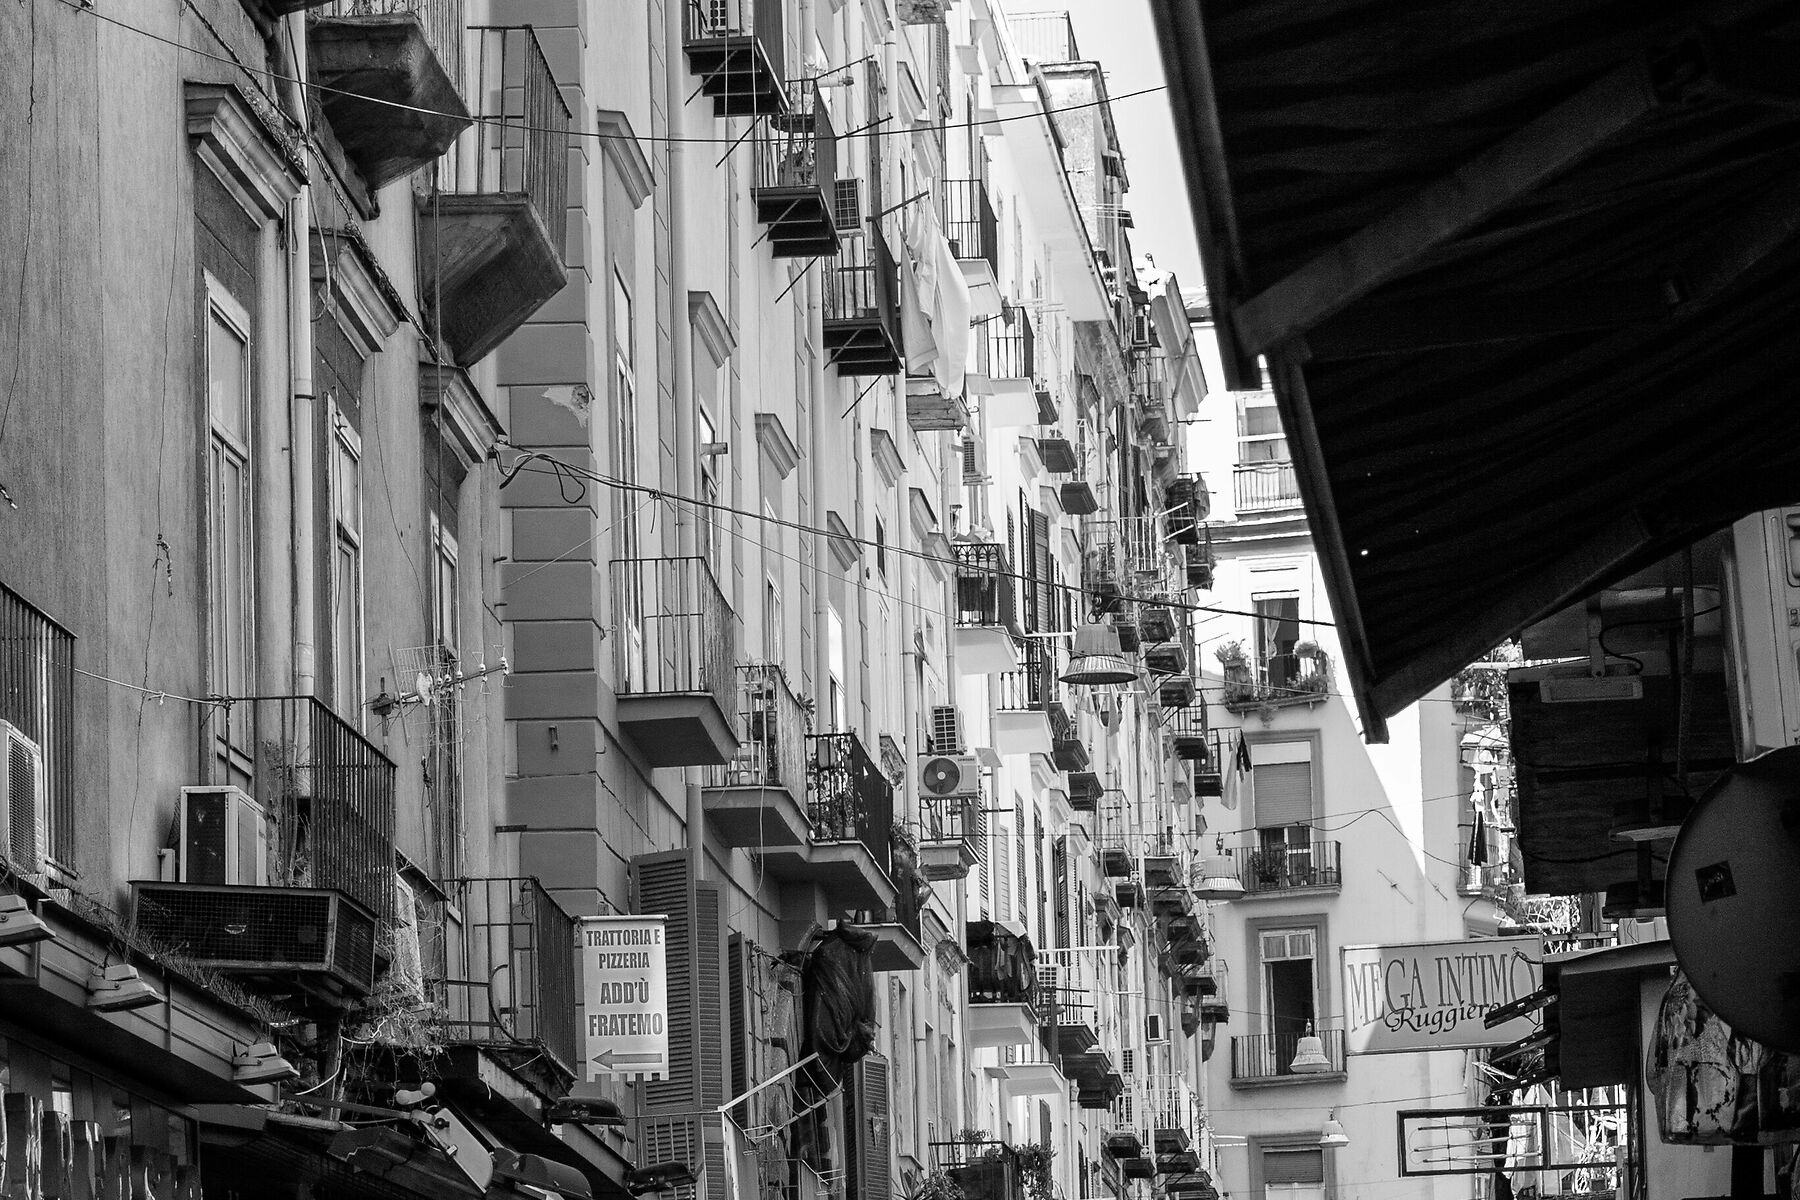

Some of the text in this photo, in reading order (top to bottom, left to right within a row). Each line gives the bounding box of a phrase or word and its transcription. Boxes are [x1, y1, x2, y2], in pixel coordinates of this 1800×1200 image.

[586, 928, 661, 947] TRATTORIA E
[598, 952, 650, 969] PIZZERIA
[600, 977, 650, 1005] ADD'Ù
[1347, 951, 1536, 1033] MEGA INTIMO
[588, 1012, 663, 1037] FRATEMO
